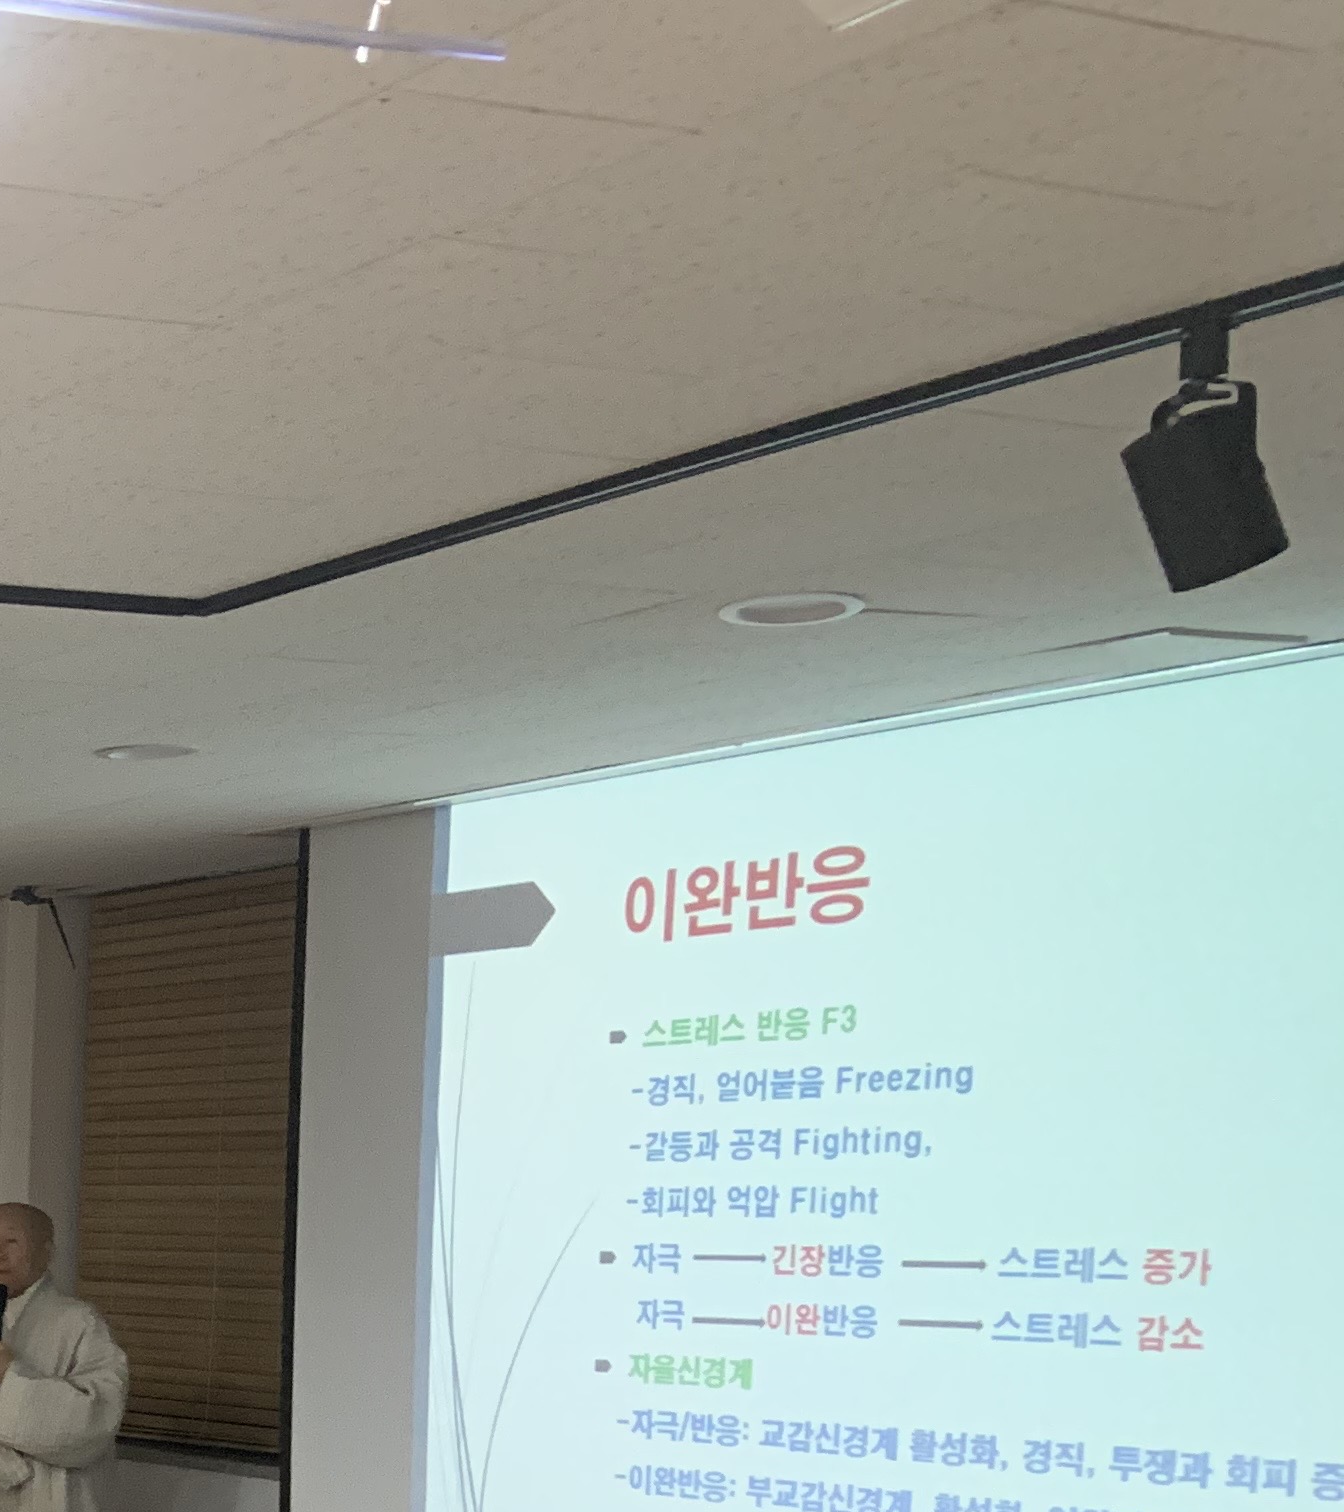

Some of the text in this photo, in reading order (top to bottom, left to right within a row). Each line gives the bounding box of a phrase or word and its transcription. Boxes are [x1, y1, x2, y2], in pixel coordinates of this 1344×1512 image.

[624, 845, 870, 942] 이완반응
[642, 1005, 857, 1048] 스트레스 반응 F3
[835, 1062, 974, 1096] Freezing
[629, 1124, 932, 1162] -갈등과 공격 Fighting,
[727, 1185, 778, 1218] 억압
[789, 1185, 878, 1218] Flight
[632, 1242, 1212, 1286] 자극 긴장반응 스트레스 증가
[636, 1299, 1204, 1352] 자극 이완반응 스트레스 감소
[628, 1352, 754, 1390] 자율신경계
[759, 1418, 899, 1461] 교감신경계
[1225, 1454, 1297, 1497] 회피
